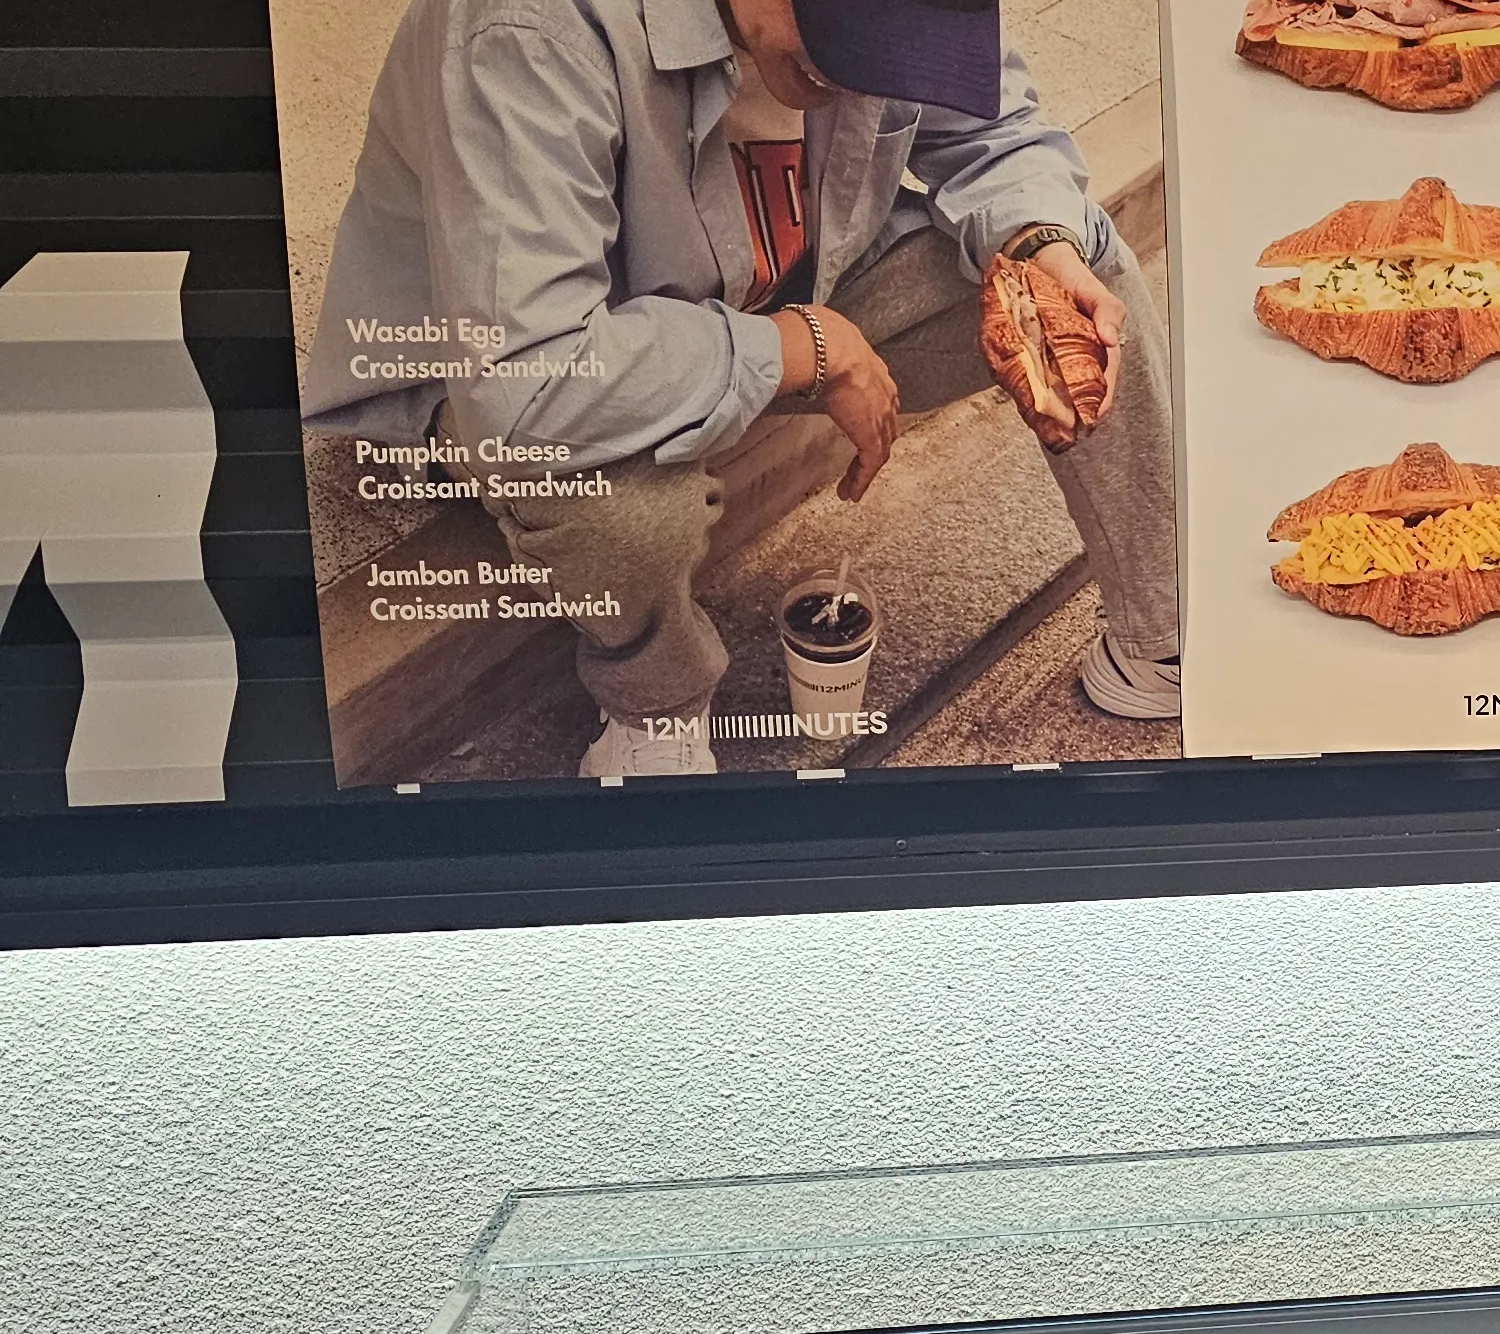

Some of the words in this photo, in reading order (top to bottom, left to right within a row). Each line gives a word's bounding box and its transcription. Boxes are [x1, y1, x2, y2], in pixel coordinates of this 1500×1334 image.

[346, 316, 448, 343] Wasabi
[457, 318, 506, 349] Egg
[350, 354, 472, 379] Croissant
[480, 351, 605, 378] Sandwich
[355, 437, 470, 470] Pumpkin
[477, 437, 571, 463] Cheese
[358, 475, 481, 500] Croissant
[487, 471, 612, 498] Sandwich
[367, 560, 470, 587] Jambon
[478, 561, 552, 585] Butter
[370, 596, 490, 621] Croissant
[497, 591, 621, 619] Sandwich
